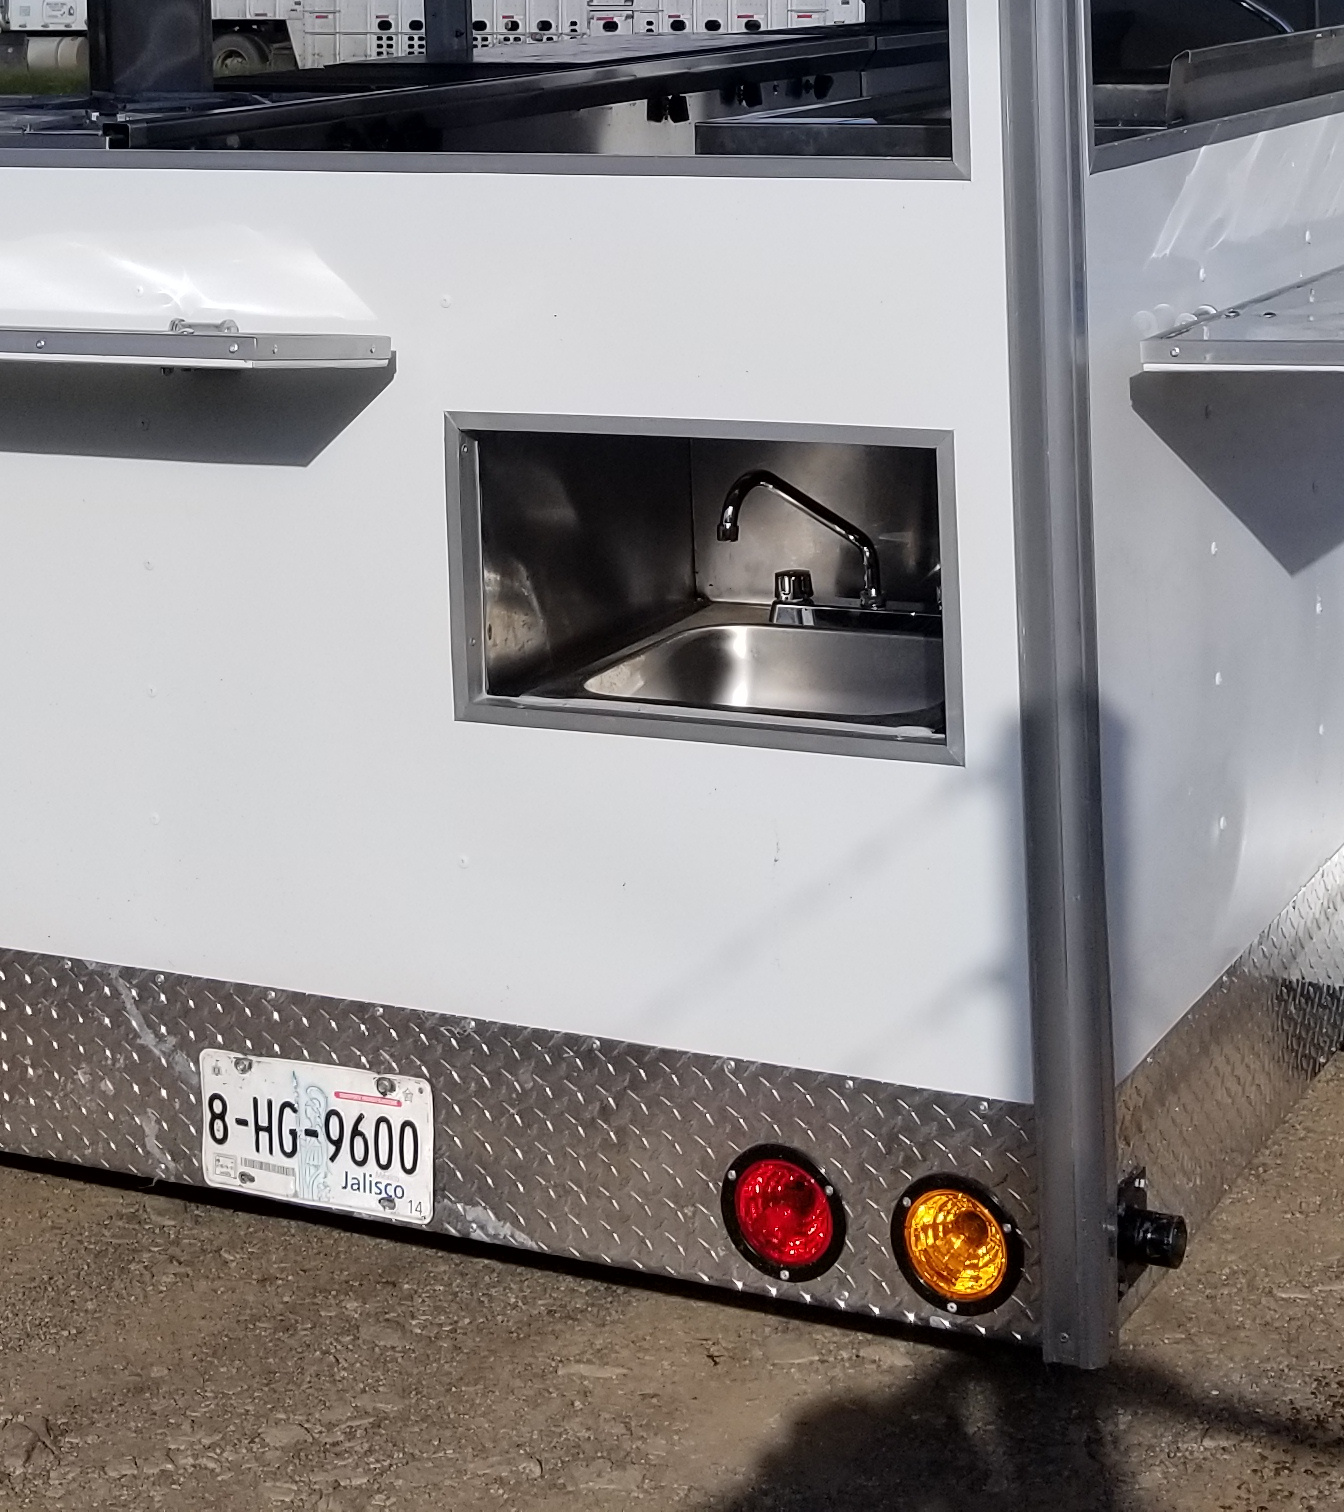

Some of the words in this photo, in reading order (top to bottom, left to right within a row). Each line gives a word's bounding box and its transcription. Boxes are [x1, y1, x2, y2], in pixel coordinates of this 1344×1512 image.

[208, 1093, 419, 1175] 8-HG-9600
[341, 1171, 405, 1199] Jalisco
[407, 1199, 423, 1216] 14
